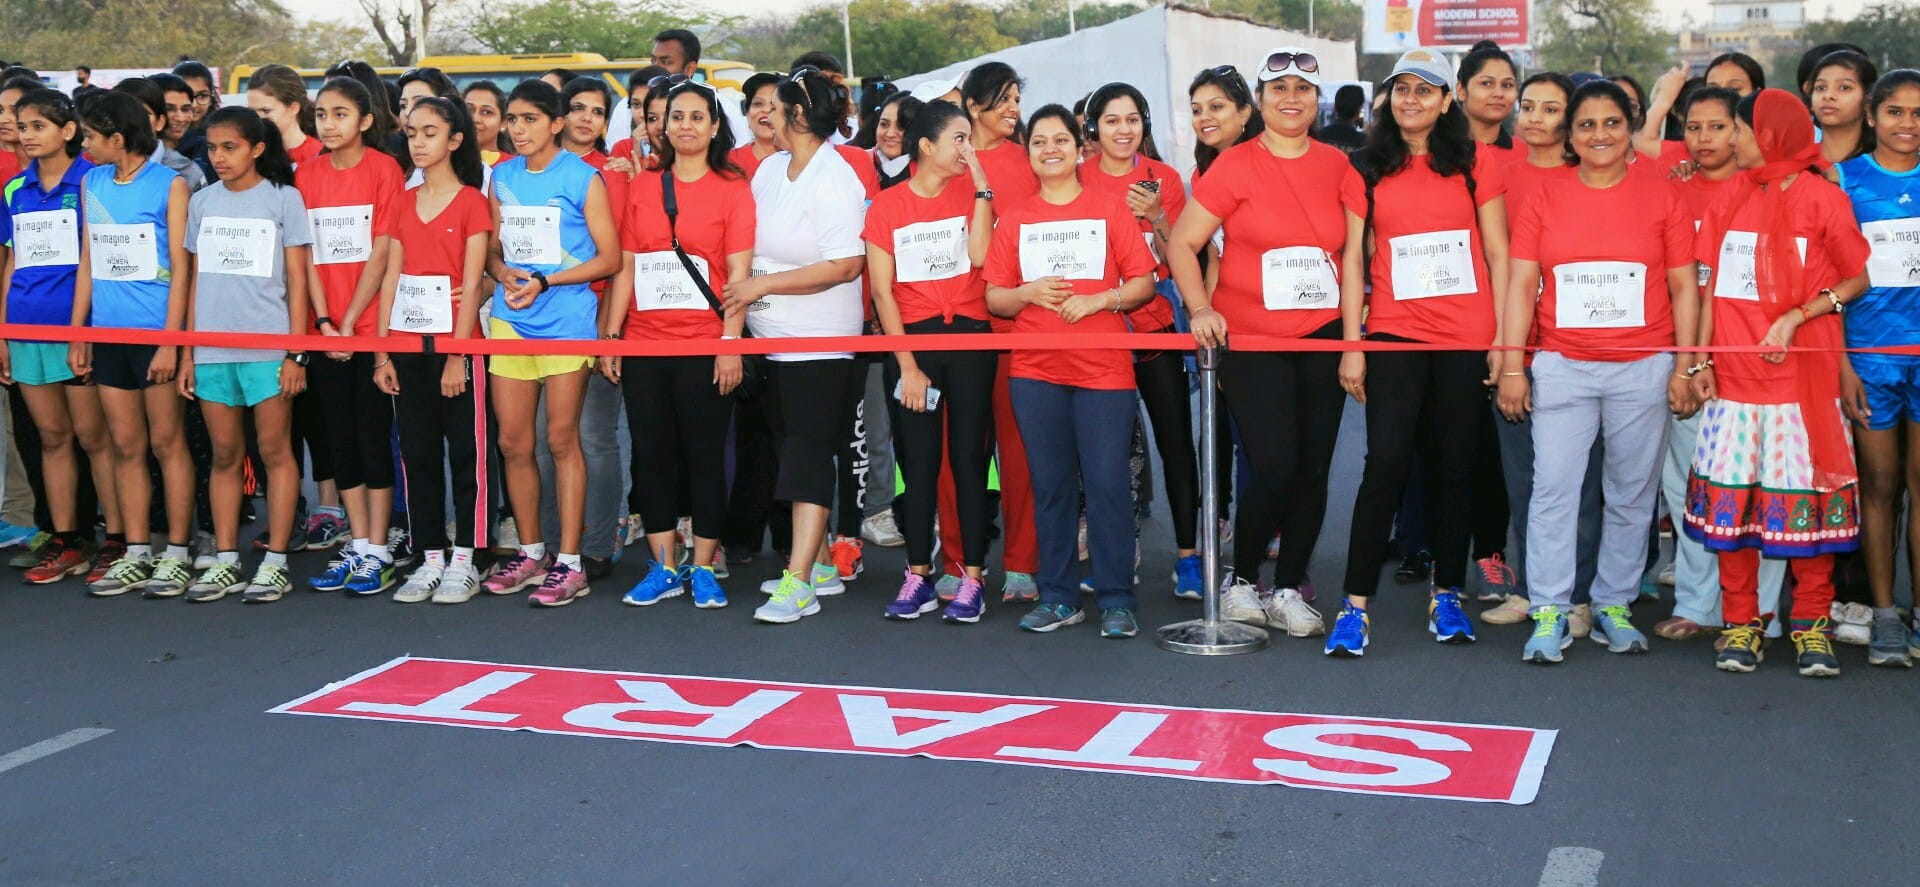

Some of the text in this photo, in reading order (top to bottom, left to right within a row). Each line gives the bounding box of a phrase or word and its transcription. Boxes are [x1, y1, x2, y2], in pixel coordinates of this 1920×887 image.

[1434, 8, 1519, 20] MODERN SCHOOL
[322, 216, 355, 229] imagine
[508, 216, 536, 229] imagine
[216, 226, 250, 239] imagine
[914, 229, 952, 243] imagine
[1042, 230, 1080, 243] imagine
[100, 233, 130, 246] imagine
[1410, 242, 1450, 258] imagine
[923, 254, 951, 265] WOMEN
[1048, 255, 1076, 264] WOMEN
[1577, 272, 1619, 287] imagine
[656, 285, 682, 293] WOMEN
[1294, 283, 1321, 292] WOMEN
[1583, 301, 1616, 309] WOMEN
[336, 671, 1472, 787] START
